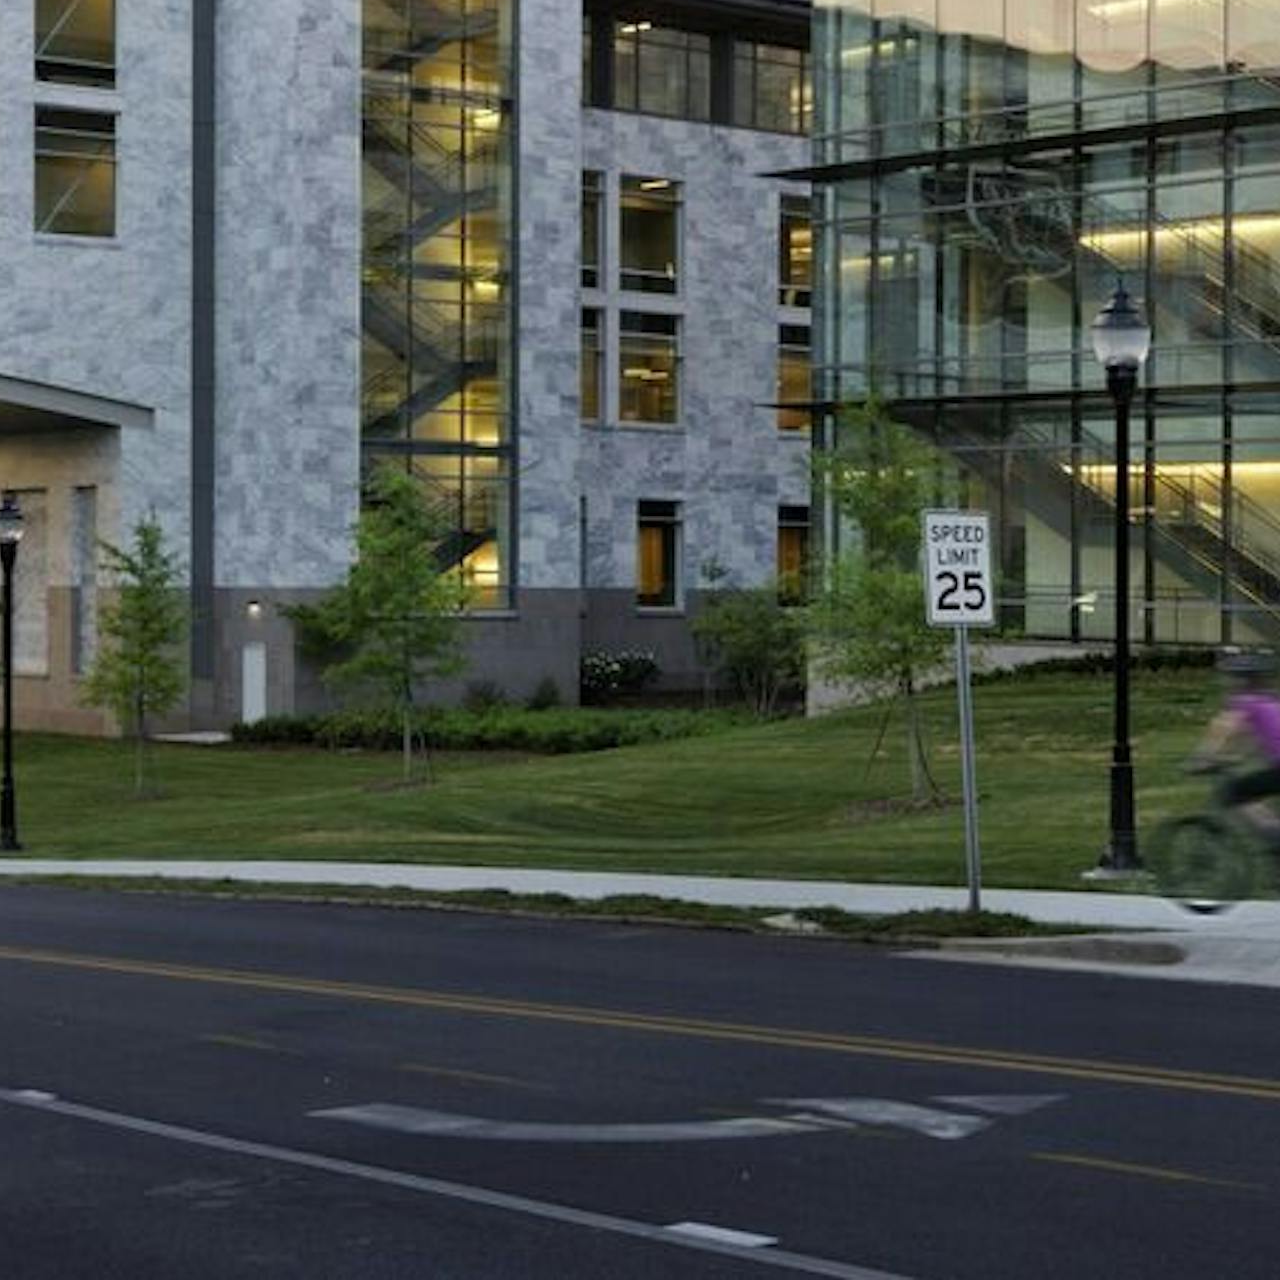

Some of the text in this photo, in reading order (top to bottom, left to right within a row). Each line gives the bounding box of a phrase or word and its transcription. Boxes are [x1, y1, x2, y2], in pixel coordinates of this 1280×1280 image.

[931, 525, 984, 542] SPEED
[937, 549, 978, 565] LIMIT
[936, 572, 986, 610] 25
